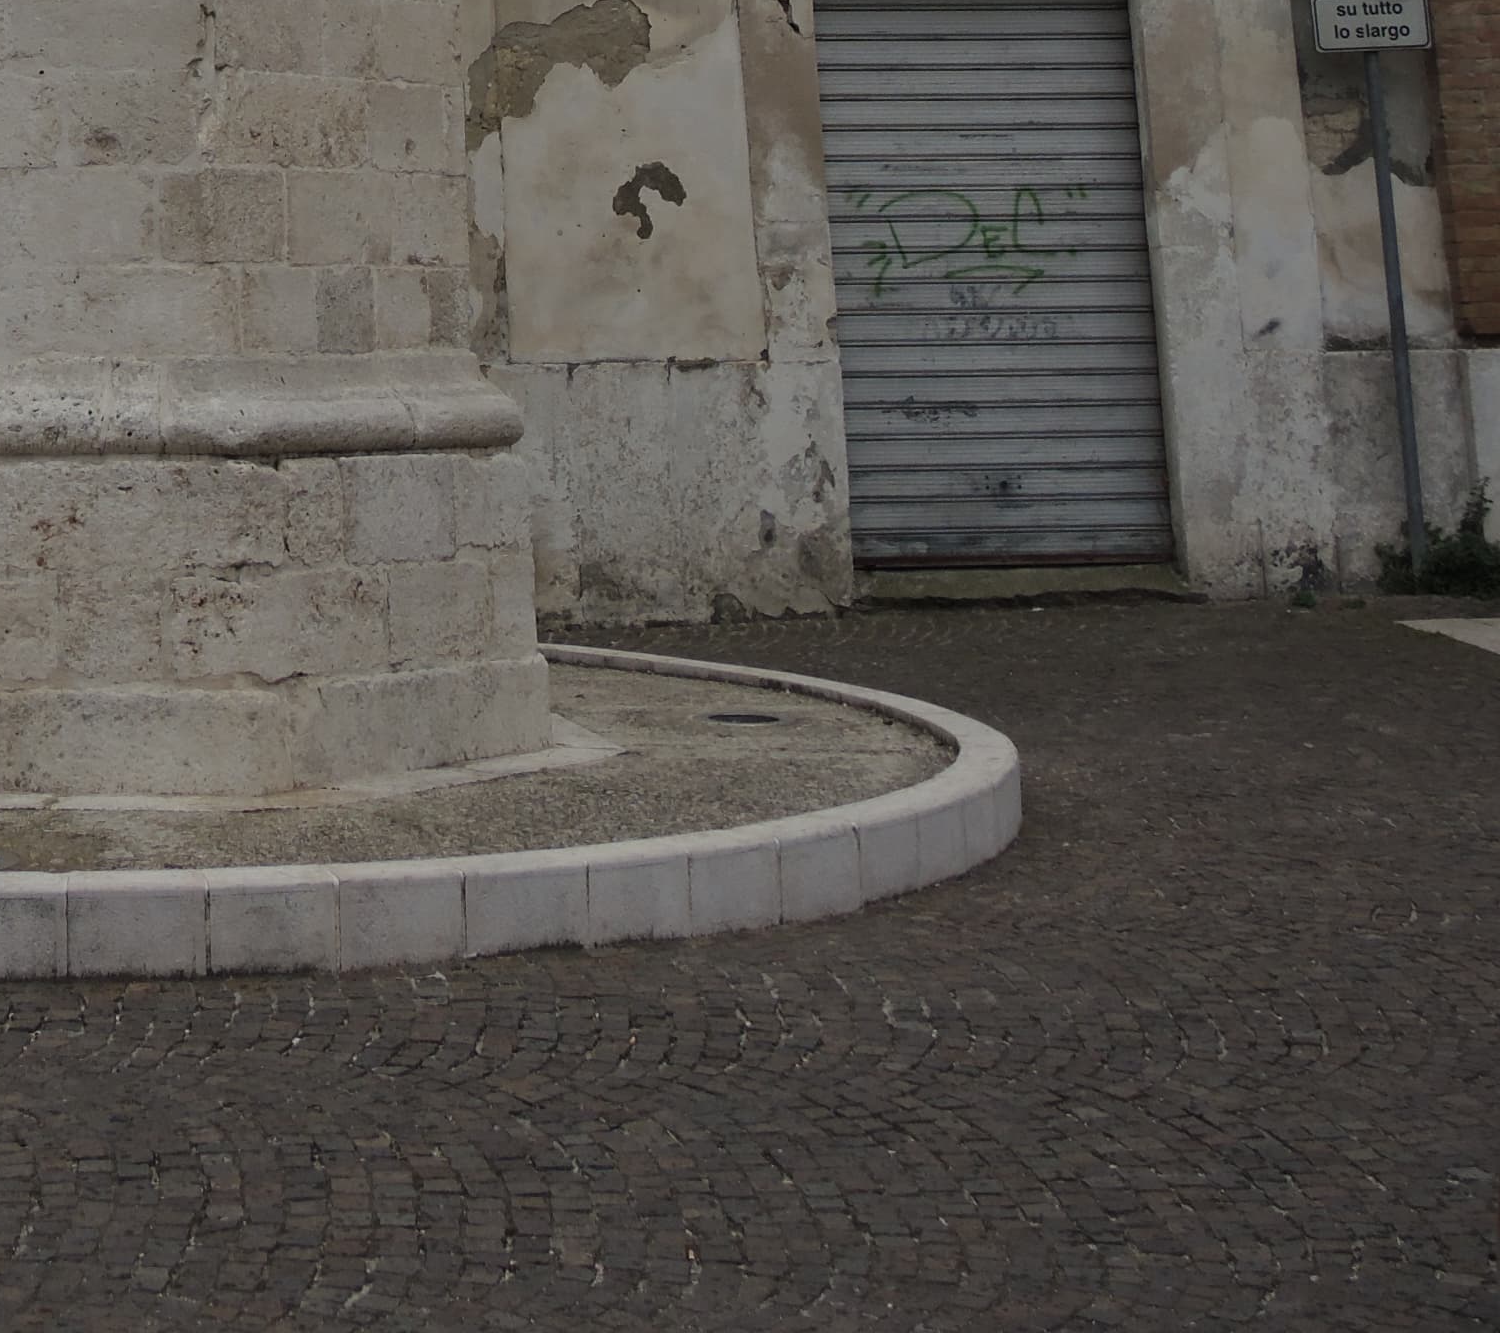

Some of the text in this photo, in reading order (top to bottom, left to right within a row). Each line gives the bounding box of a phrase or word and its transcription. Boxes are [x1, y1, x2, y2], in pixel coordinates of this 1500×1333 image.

[1336, 1, 1403, 17] su tutto
[1334, 23, 1411, 41] lo slargo
